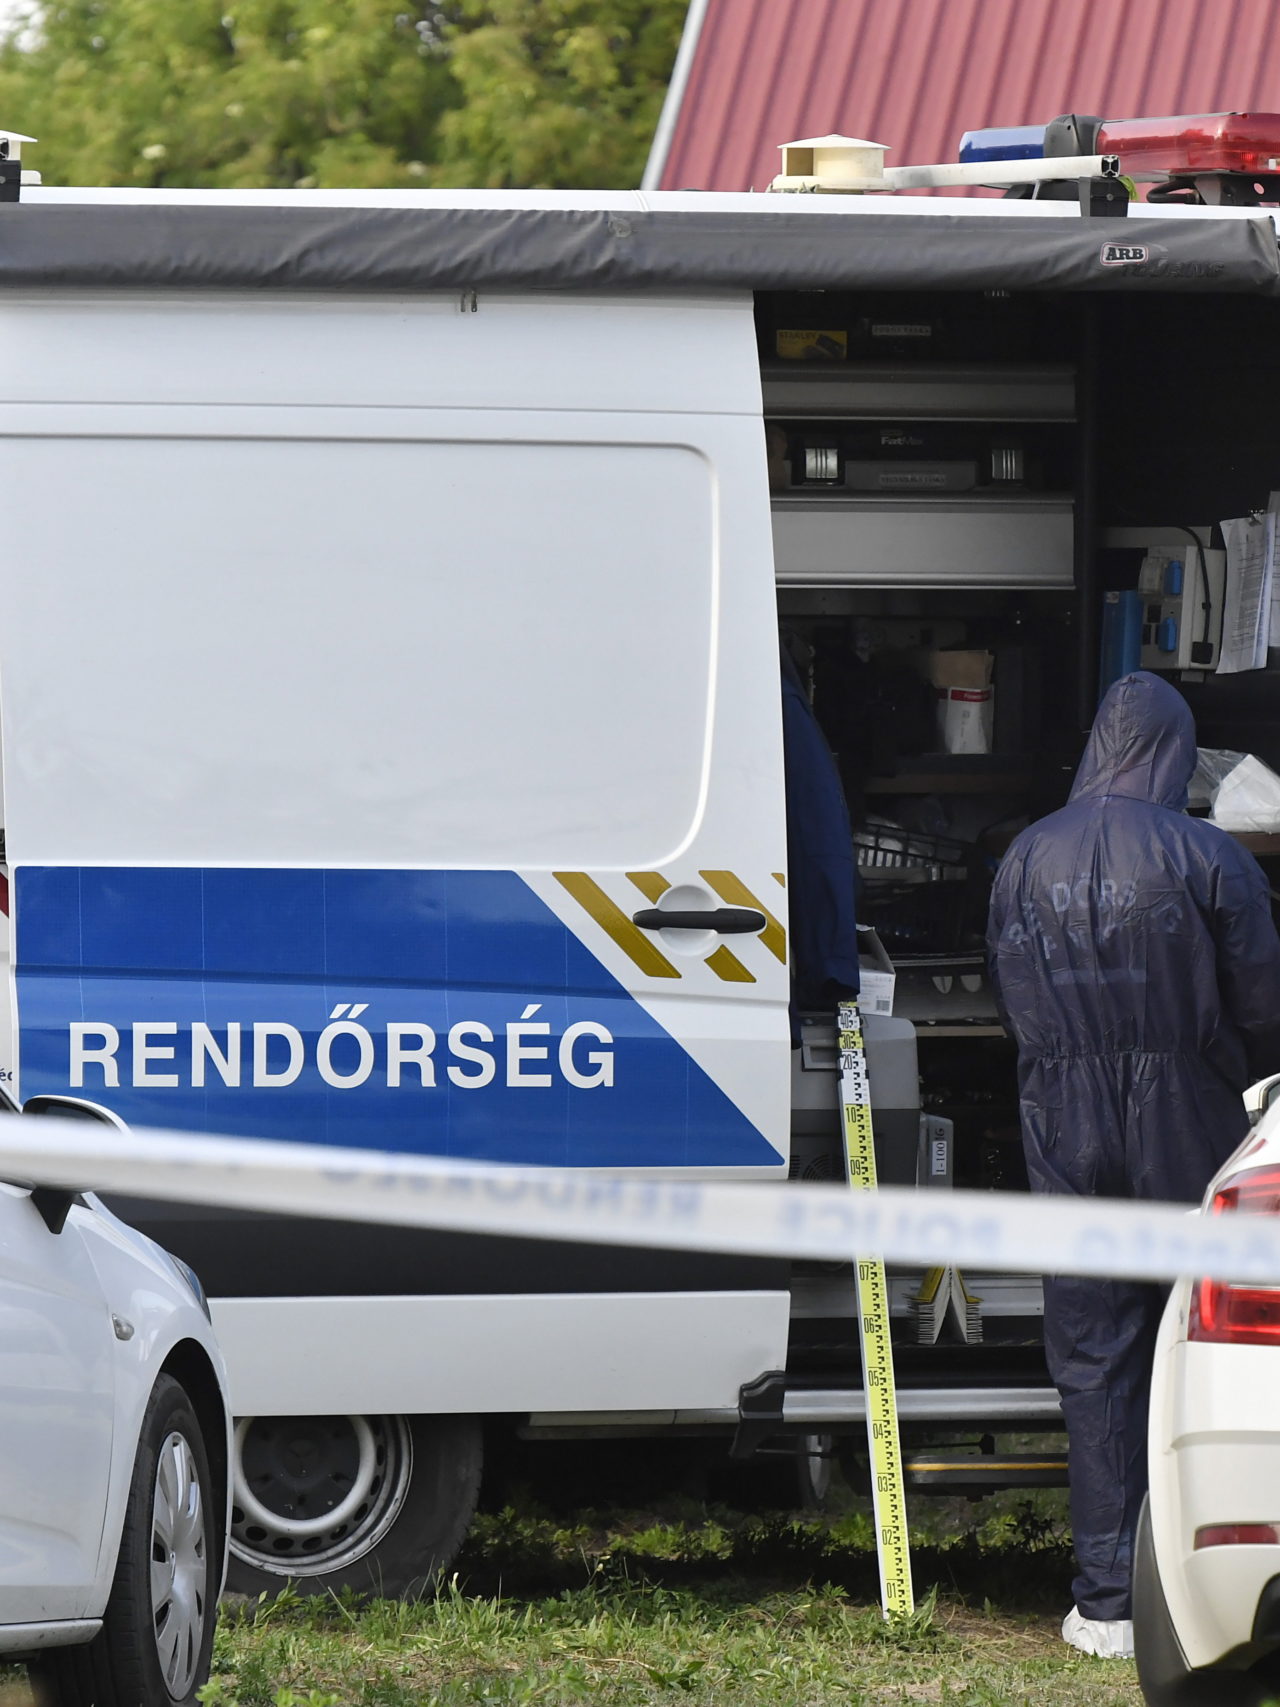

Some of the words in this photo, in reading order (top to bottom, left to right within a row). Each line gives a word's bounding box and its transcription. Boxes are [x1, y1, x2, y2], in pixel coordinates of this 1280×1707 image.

[1105, 246, 1145, 261] ARB
[69, 1003, 614, 1089] RENDŐRSÉG
[841, 1034, 850, 1050] 30
[843, 1054, 853, 1070] 20
[846, 1107, 857, 1123] 10
[850, 1159, 861, 1176] 09
[859, 1264, 870, 1281] 07
[864, 1317, 875, 1334] 06
[868, 1370, 879, 1387] 05
[873, 1423, 884, 1440] 04
[877, 1475, 888, 1492] 03
[882, 1529, 893, 1546] 02
[886, 1582, 897, 1599] 01
